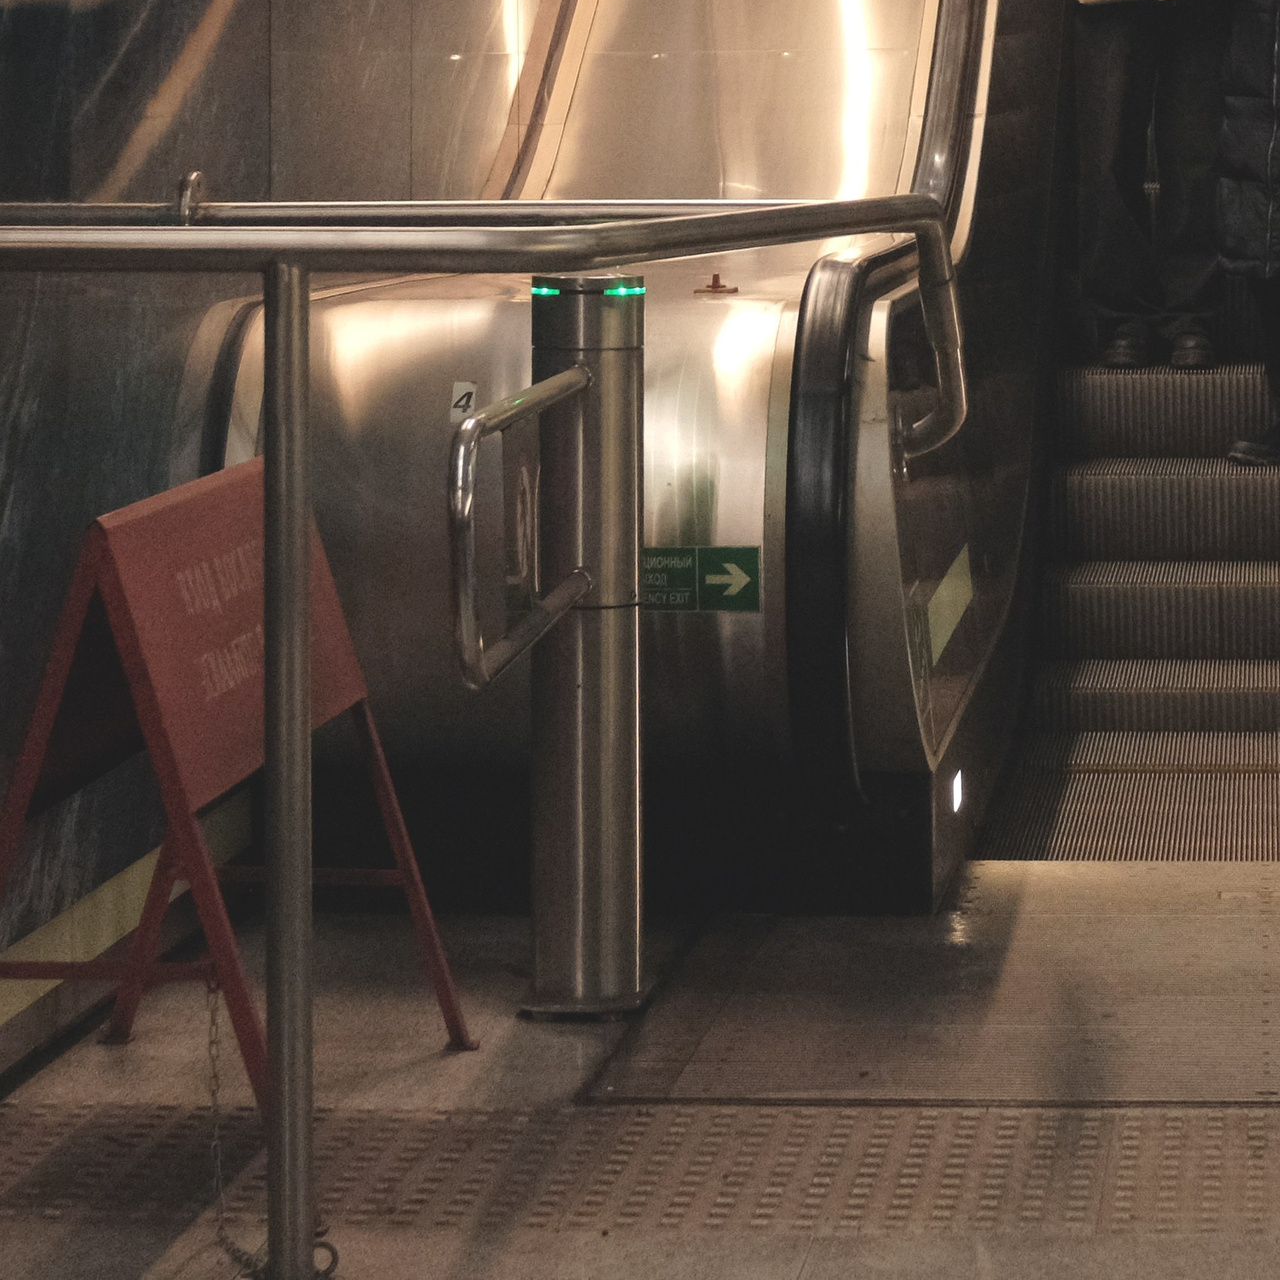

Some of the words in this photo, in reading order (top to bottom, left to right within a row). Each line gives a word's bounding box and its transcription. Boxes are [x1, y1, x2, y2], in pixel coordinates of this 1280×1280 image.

[453, 391, 474, 413] 4
[643, 554, 692, 569] ЦИОННЫЙ
[644, 573, 668, 586] ХОД
[669, 592, 691, 604] EXIT
